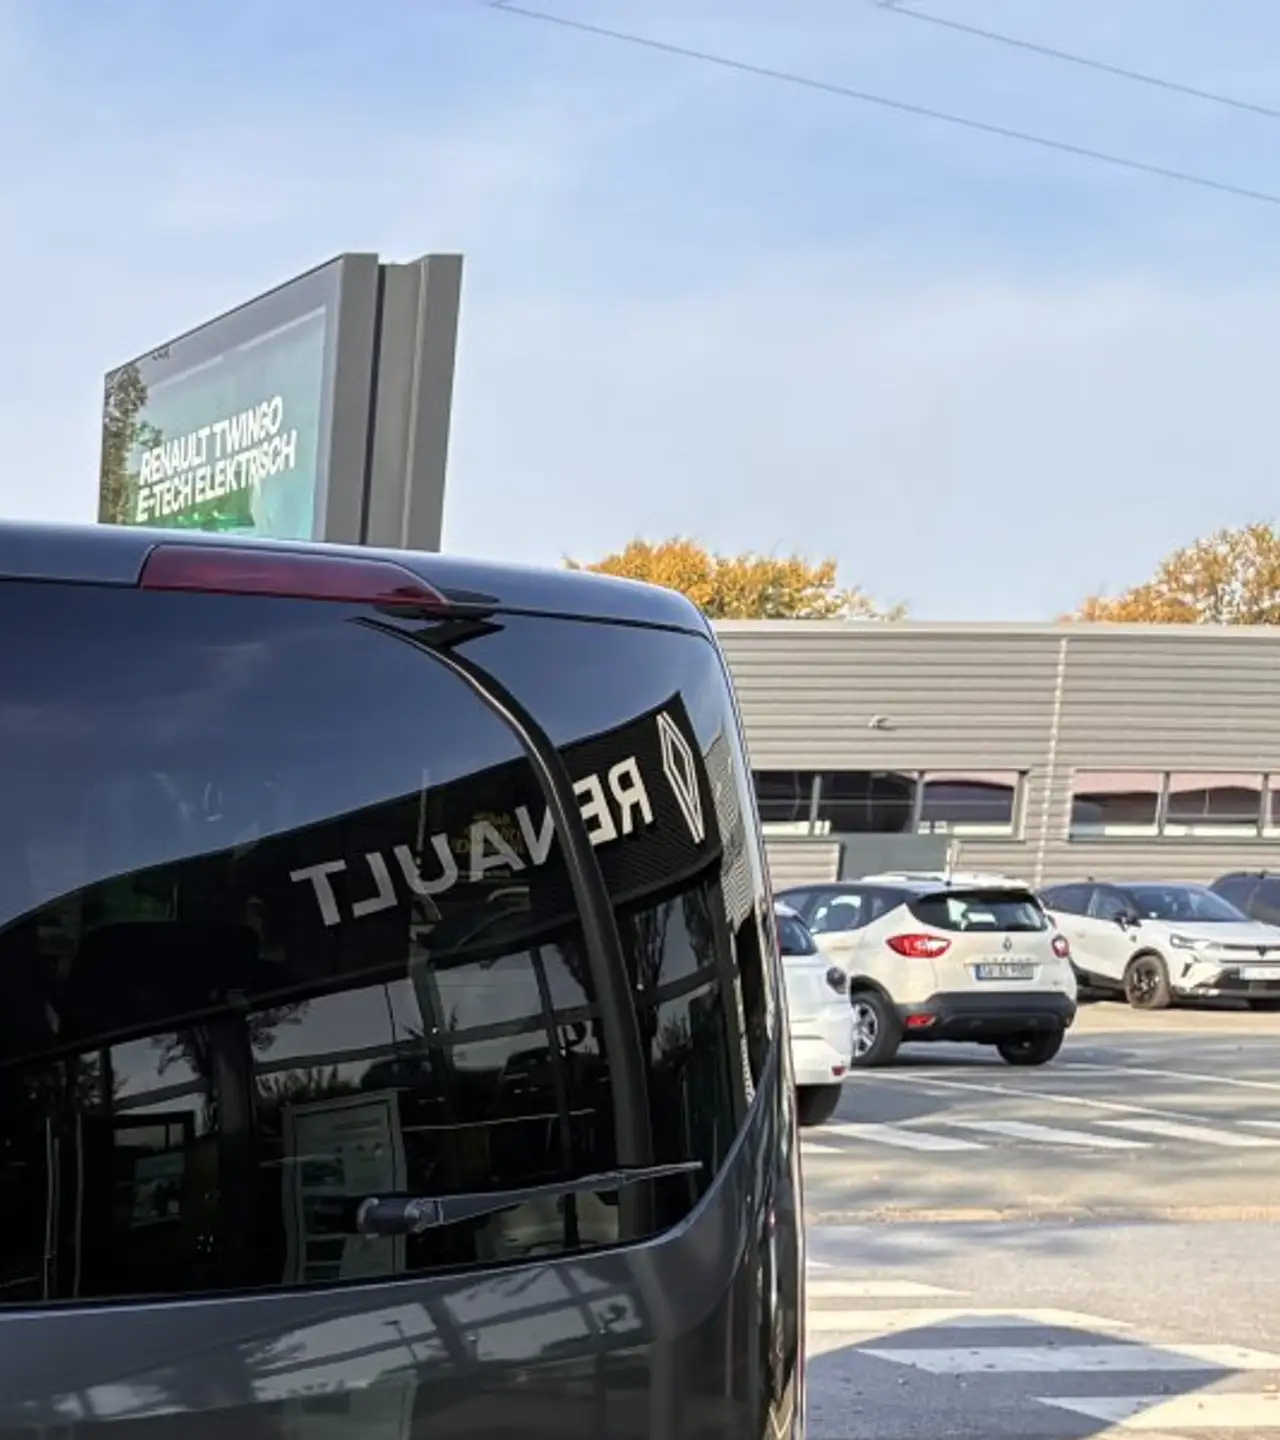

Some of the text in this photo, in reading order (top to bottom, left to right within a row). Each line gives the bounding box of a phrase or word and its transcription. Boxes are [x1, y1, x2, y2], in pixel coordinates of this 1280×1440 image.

[136, 430, 297, 522] E-TECH ELEKTRISCH
[140, 396, 282, 484] RENAULT TWINGO
